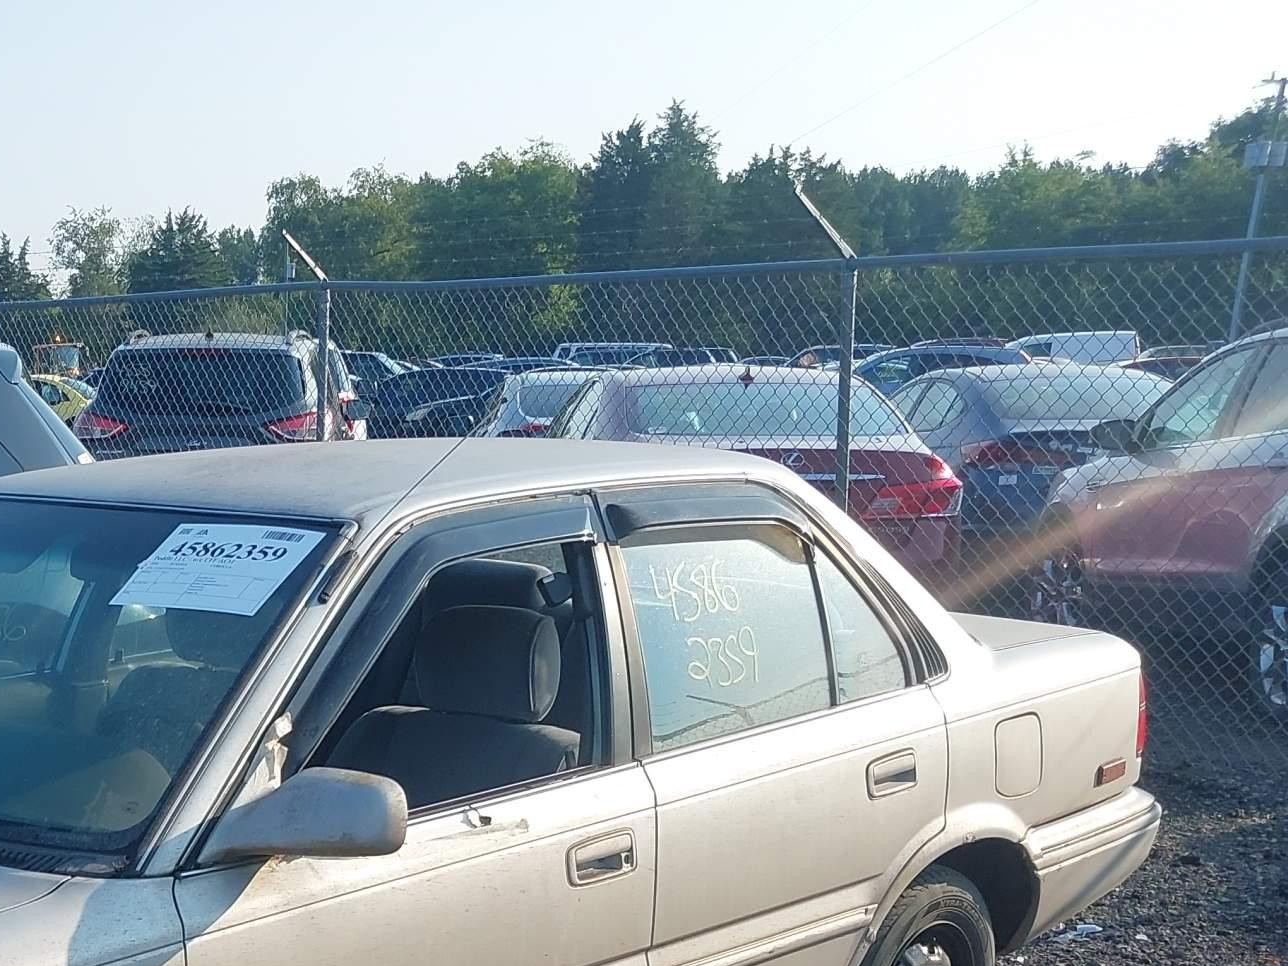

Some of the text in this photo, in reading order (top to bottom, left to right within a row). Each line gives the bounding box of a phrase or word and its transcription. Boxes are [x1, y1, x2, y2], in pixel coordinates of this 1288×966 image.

[168, 540, 289, 562] 45862359
[648, 560, 740, 622] 4586
[686, 626, 760, 687] 2359
